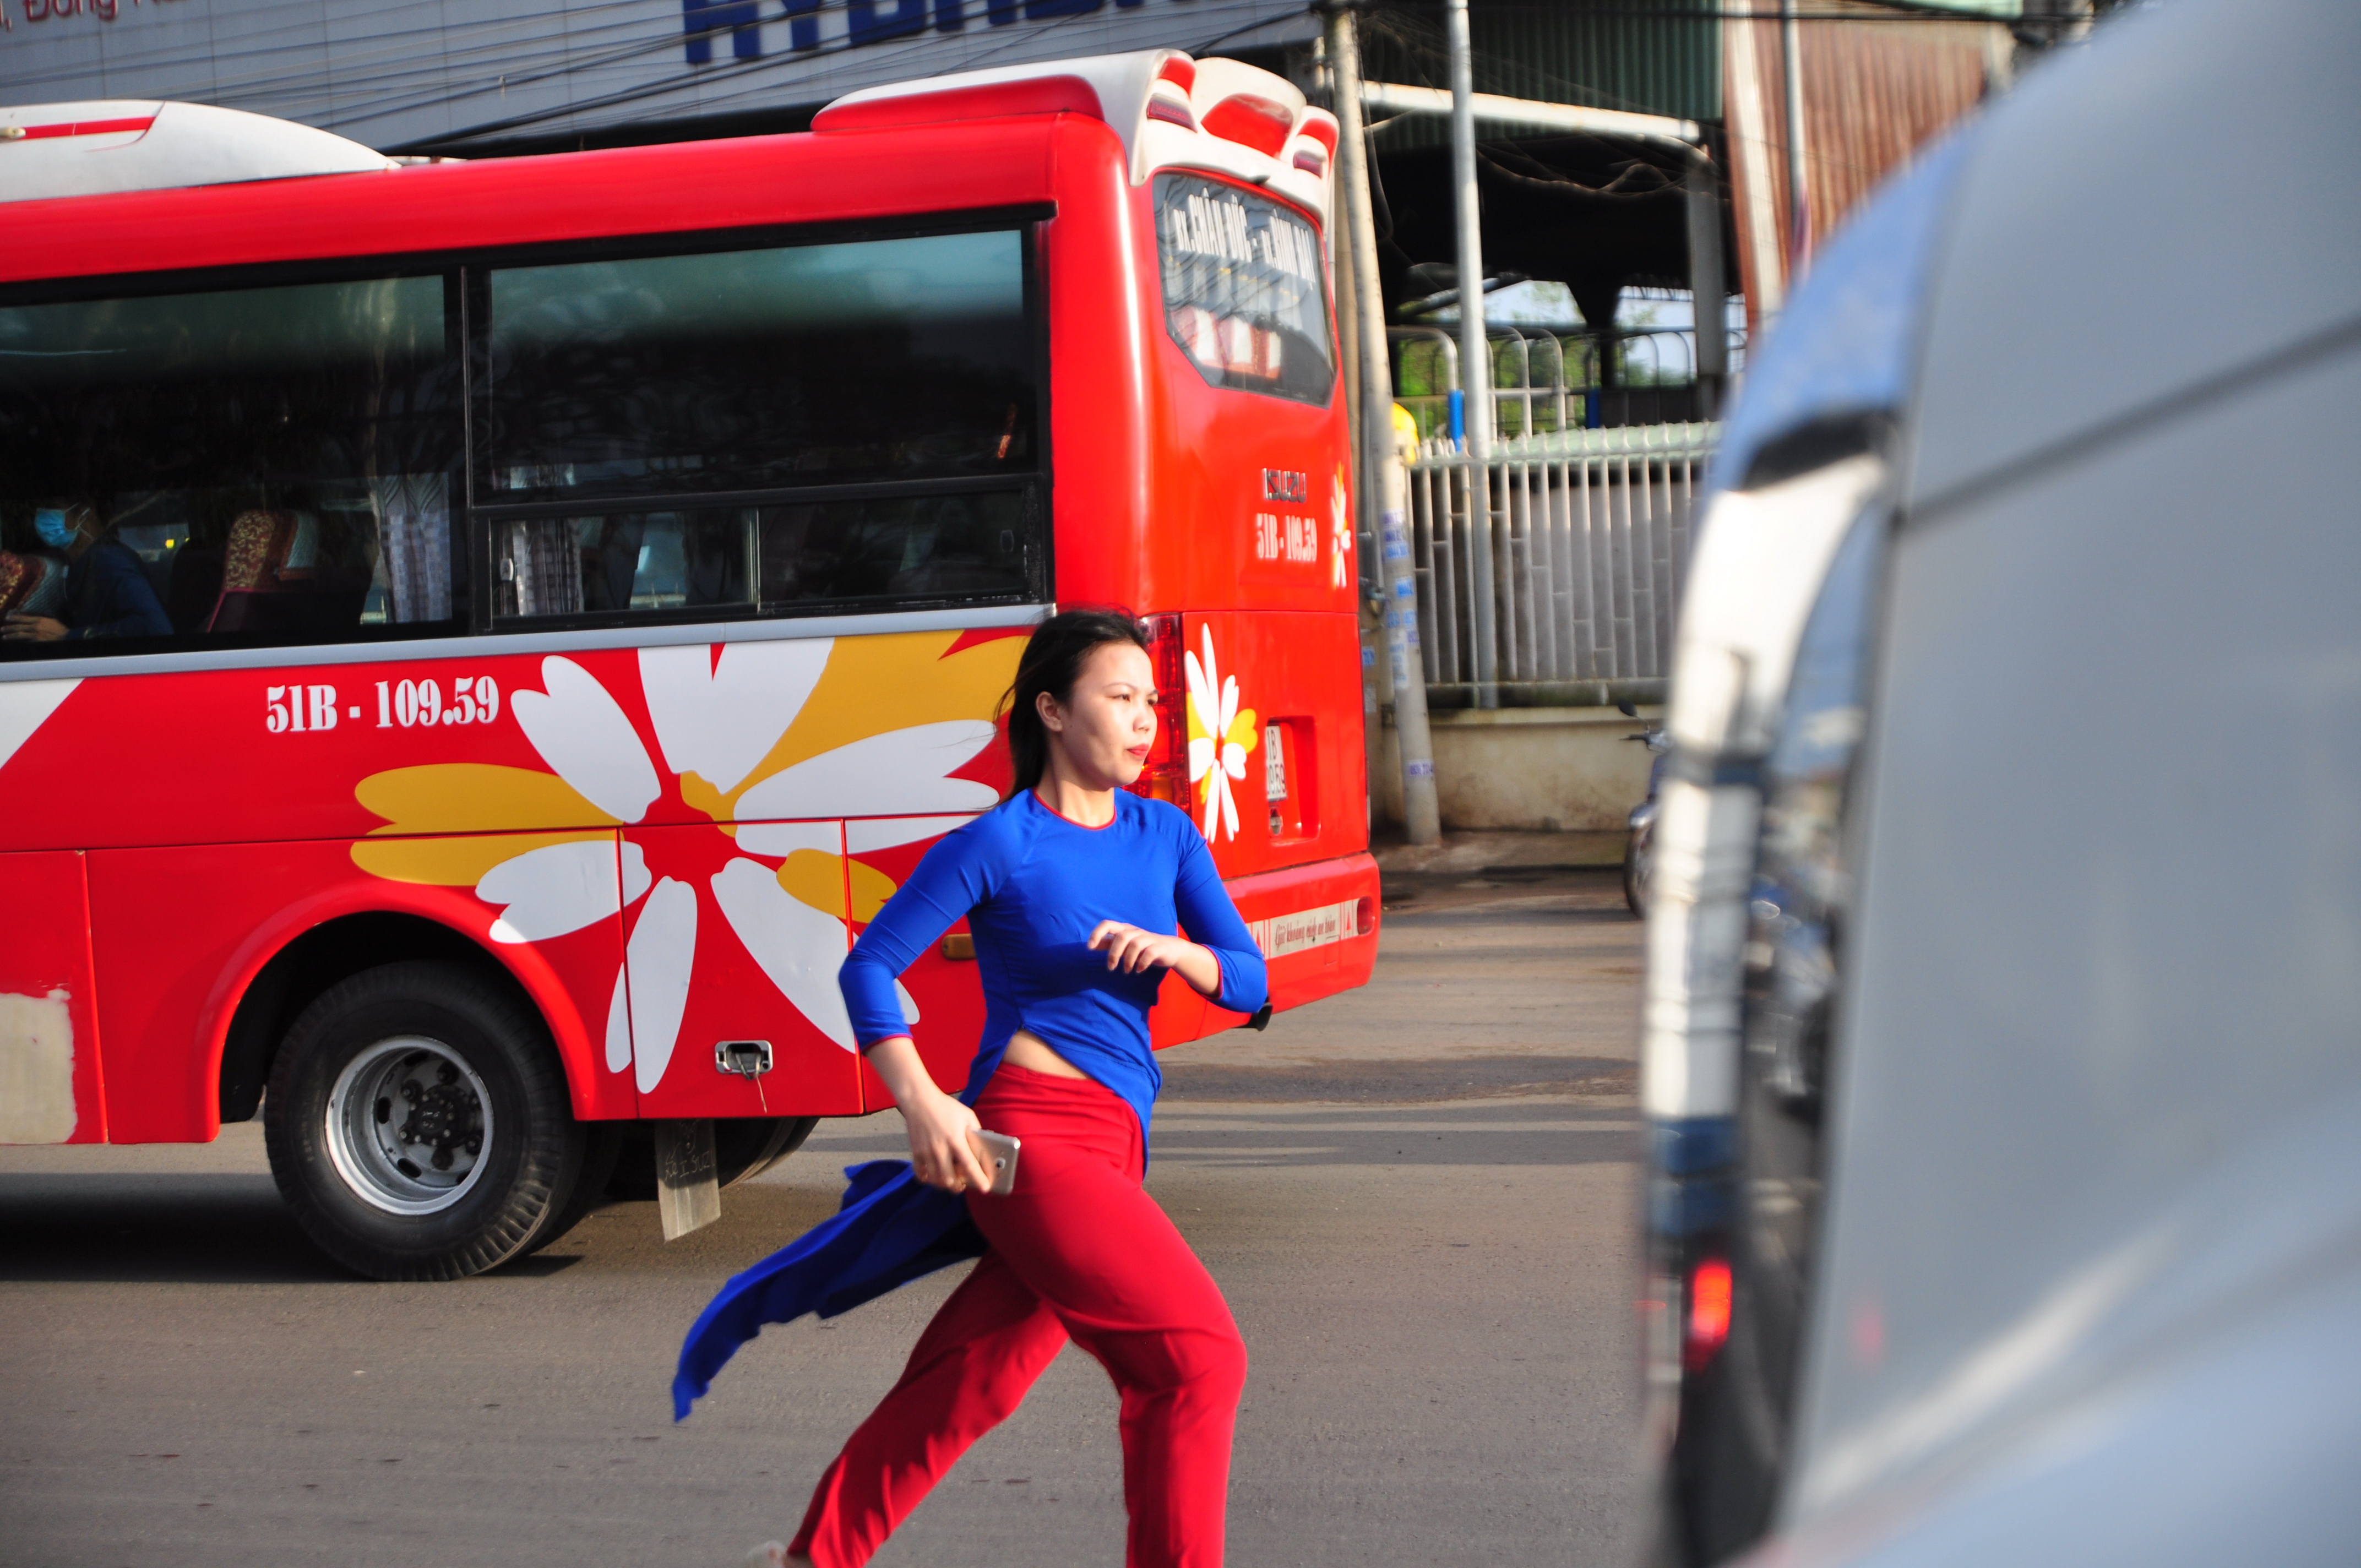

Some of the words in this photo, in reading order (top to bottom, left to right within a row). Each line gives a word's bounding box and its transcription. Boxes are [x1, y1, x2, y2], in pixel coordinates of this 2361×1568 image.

[1262, 467, 1306, 503] ISUZU
[1257, 513, 1279, 558] 51B
[1286, 515, 1317, 562] 109.59
[266, 684, 338, 733] 51B
[375, 676, 499, 728] 109.59
[1266, 729, 1277, 760] 1B
